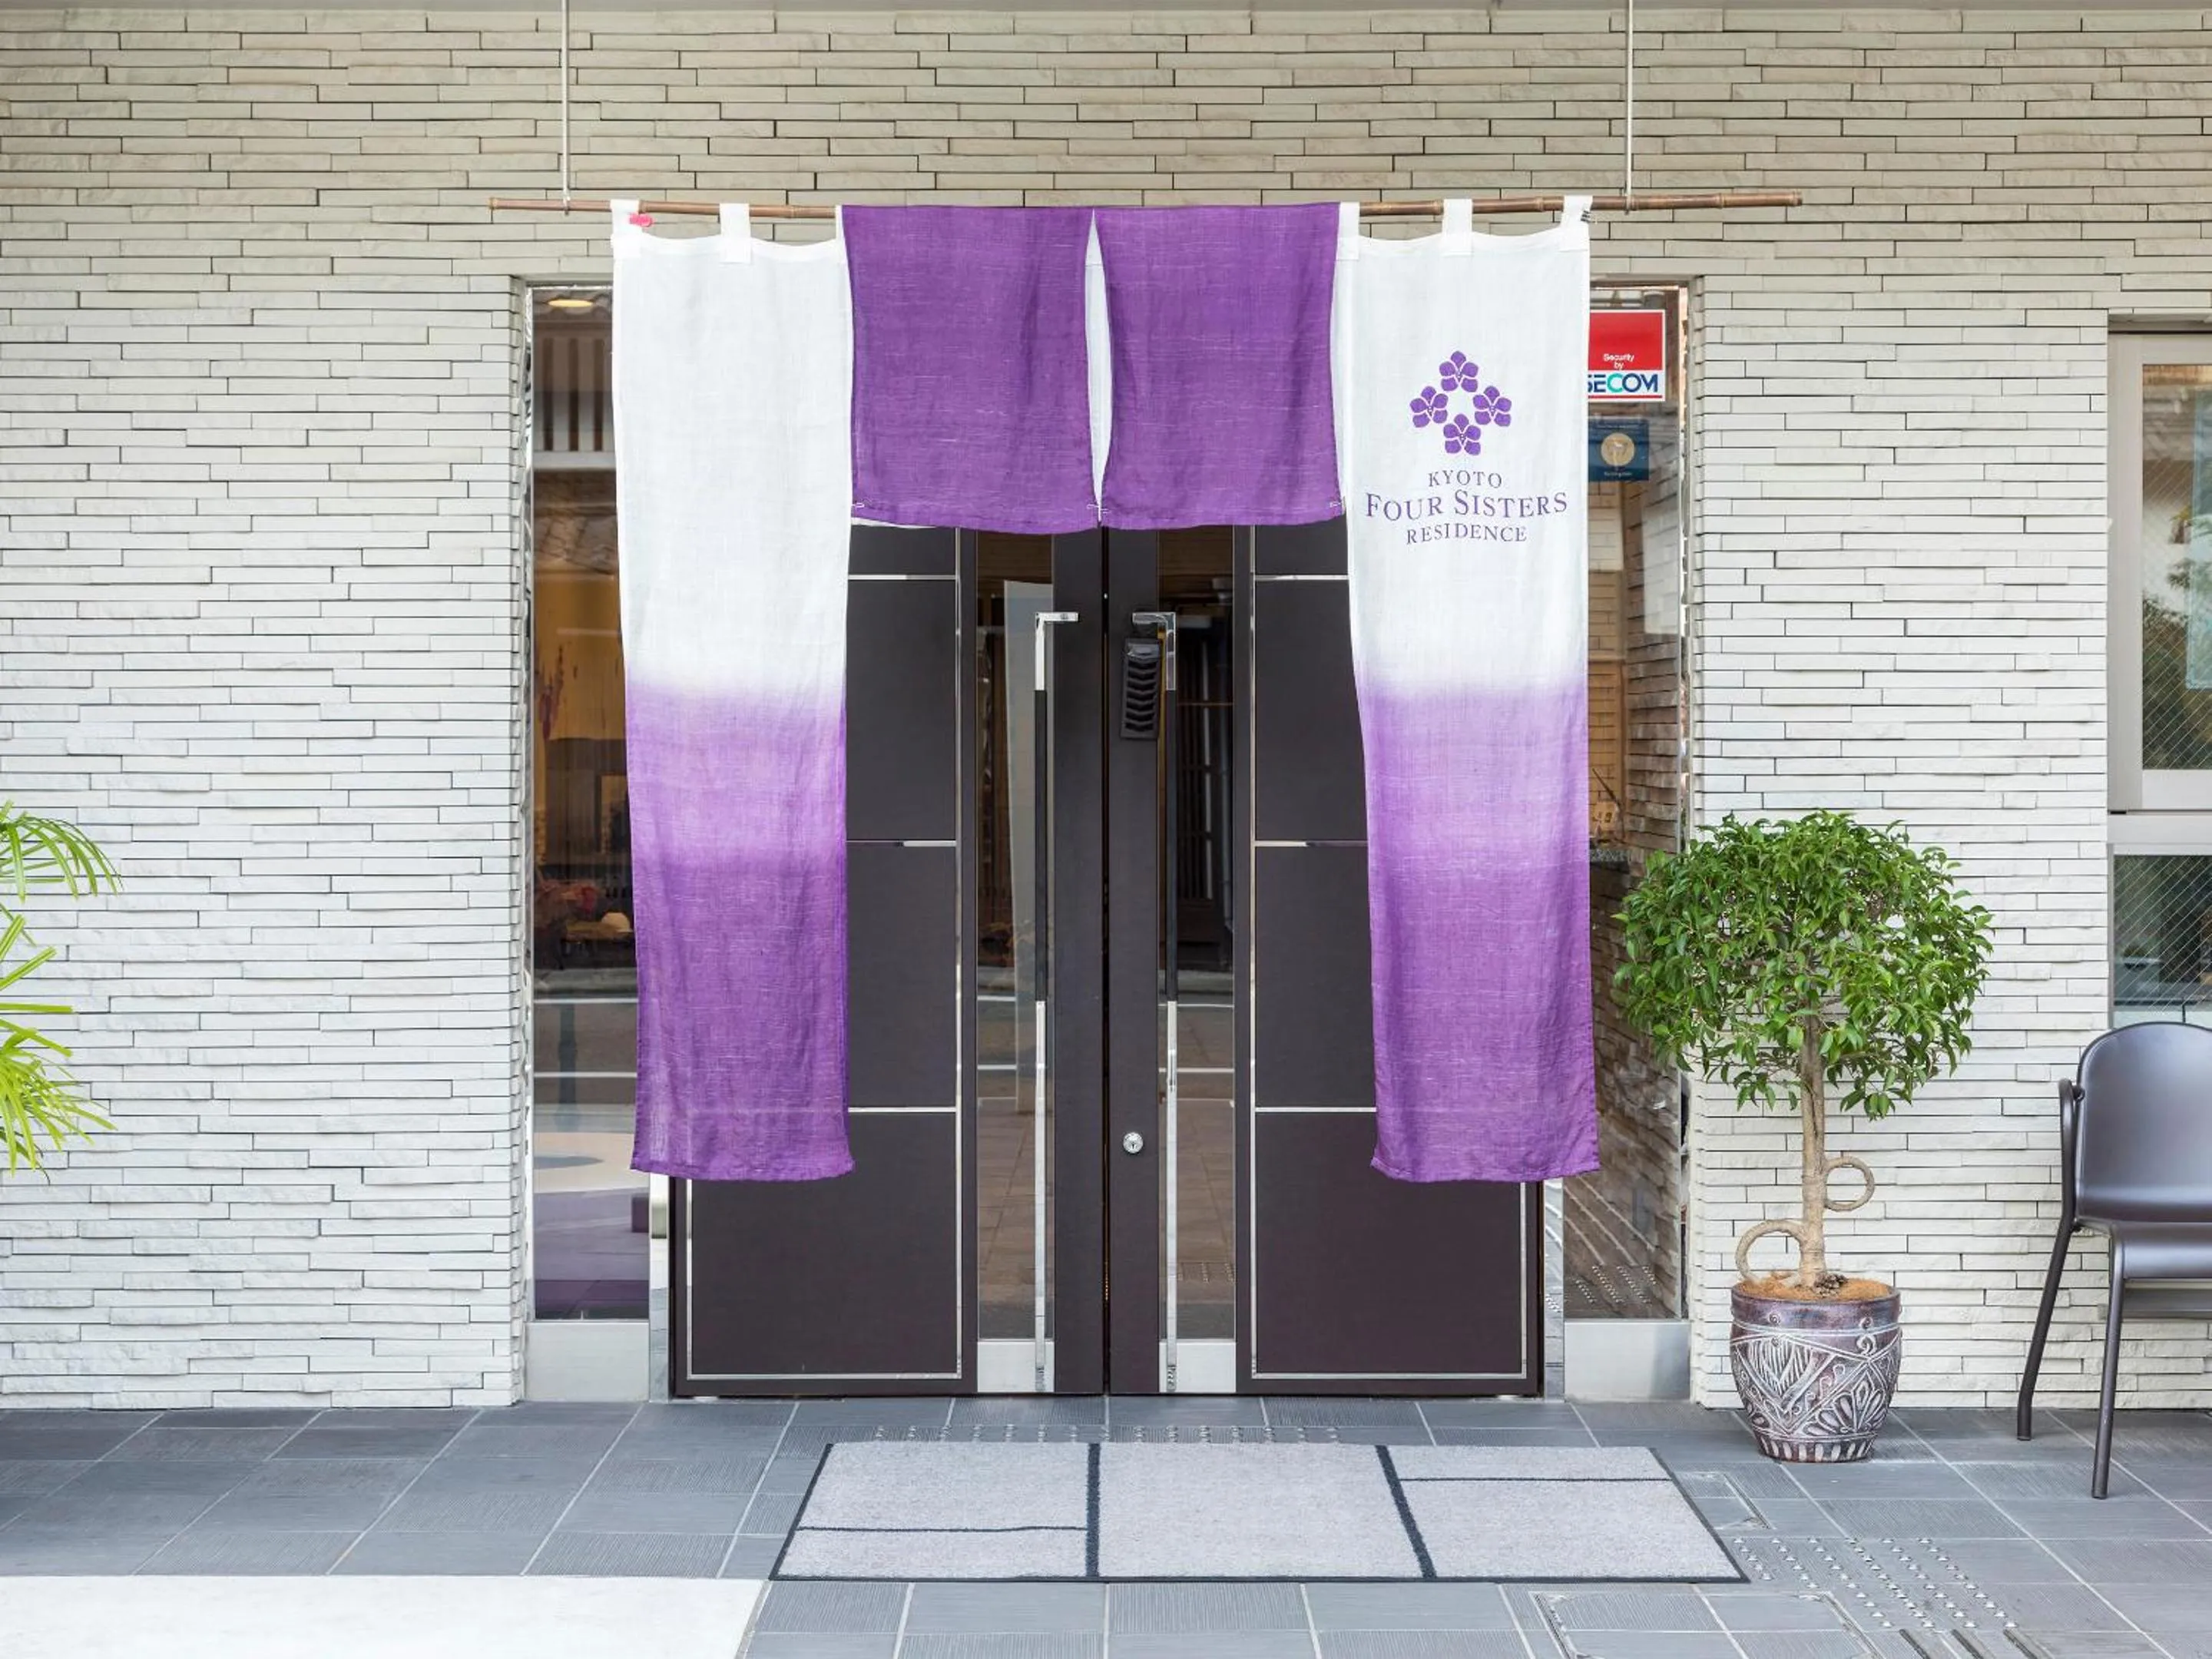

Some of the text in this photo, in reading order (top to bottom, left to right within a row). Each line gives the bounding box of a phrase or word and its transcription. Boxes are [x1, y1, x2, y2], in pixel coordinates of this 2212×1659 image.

[1603, 353, 1634, 363] Security
[1614, 362, 1624, 371] by
[1428, 469, 1502, 488] KYOTO
[1366, 489, 1568, 522] FOUR SISTERS
[1406, 522, 1528, 545] RESIDENCE
